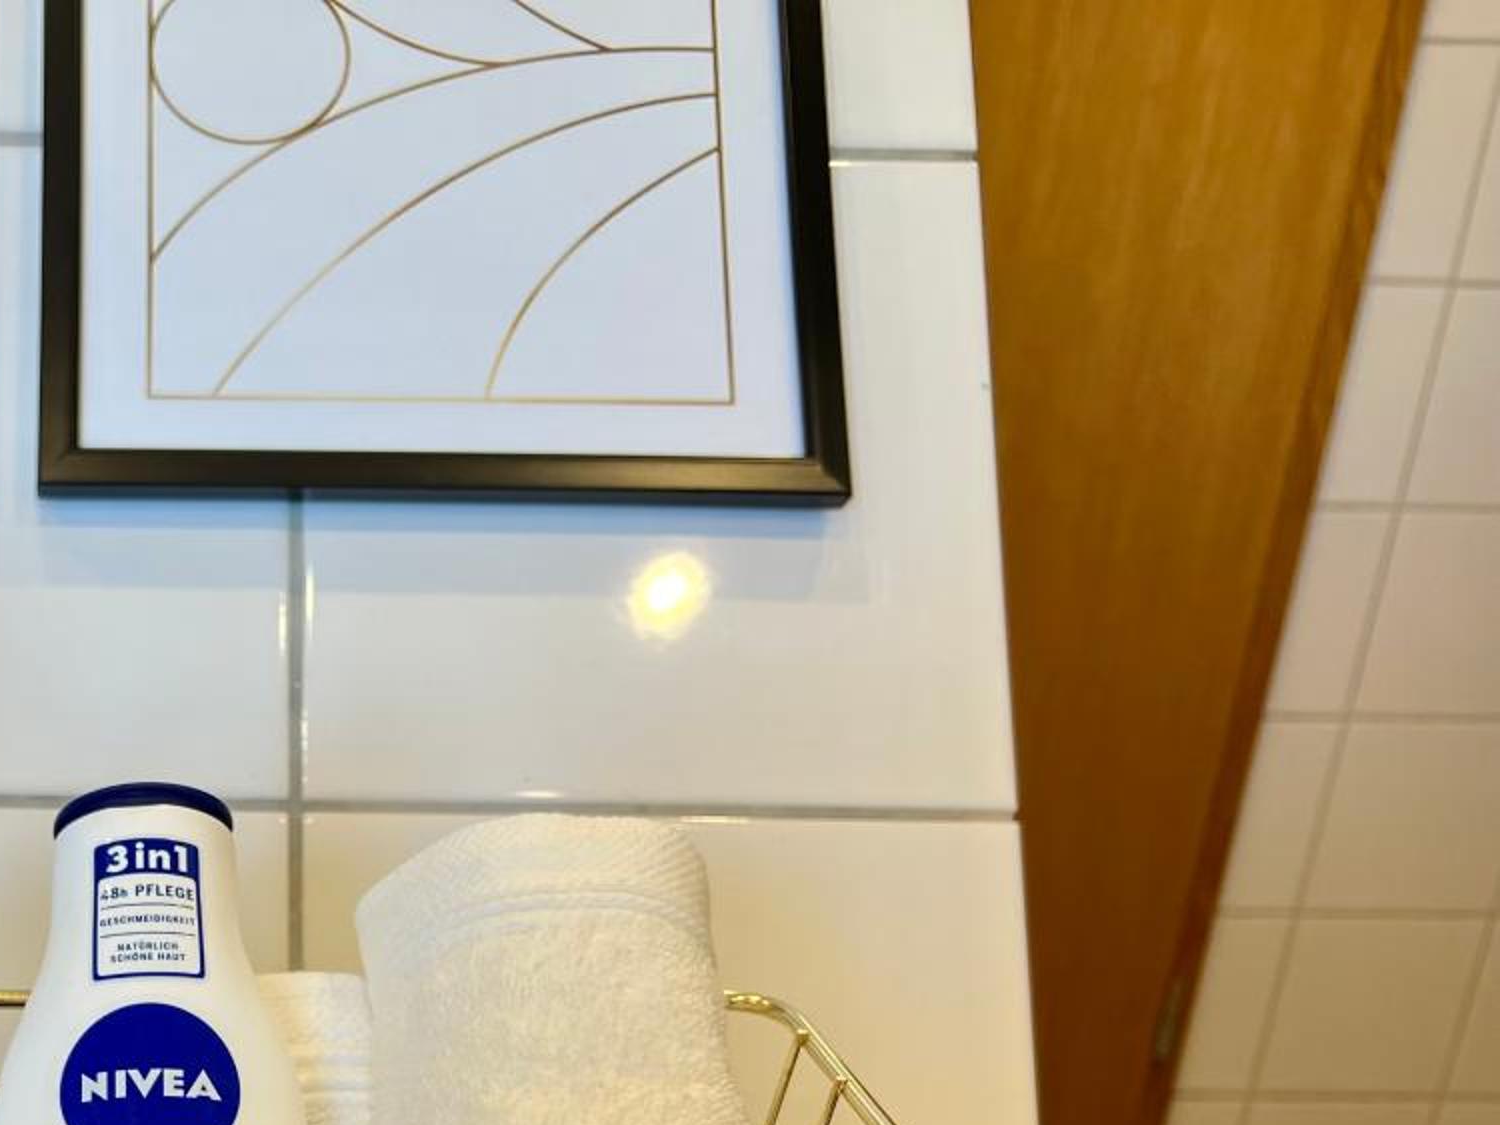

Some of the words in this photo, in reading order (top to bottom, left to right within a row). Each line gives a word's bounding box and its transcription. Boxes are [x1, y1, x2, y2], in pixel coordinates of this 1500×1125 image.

[135, 883, 194, 901] PFLEGE
[157, 953, 186, 961] HAUT
[81, 1068, 222, 1104] NIVEA
